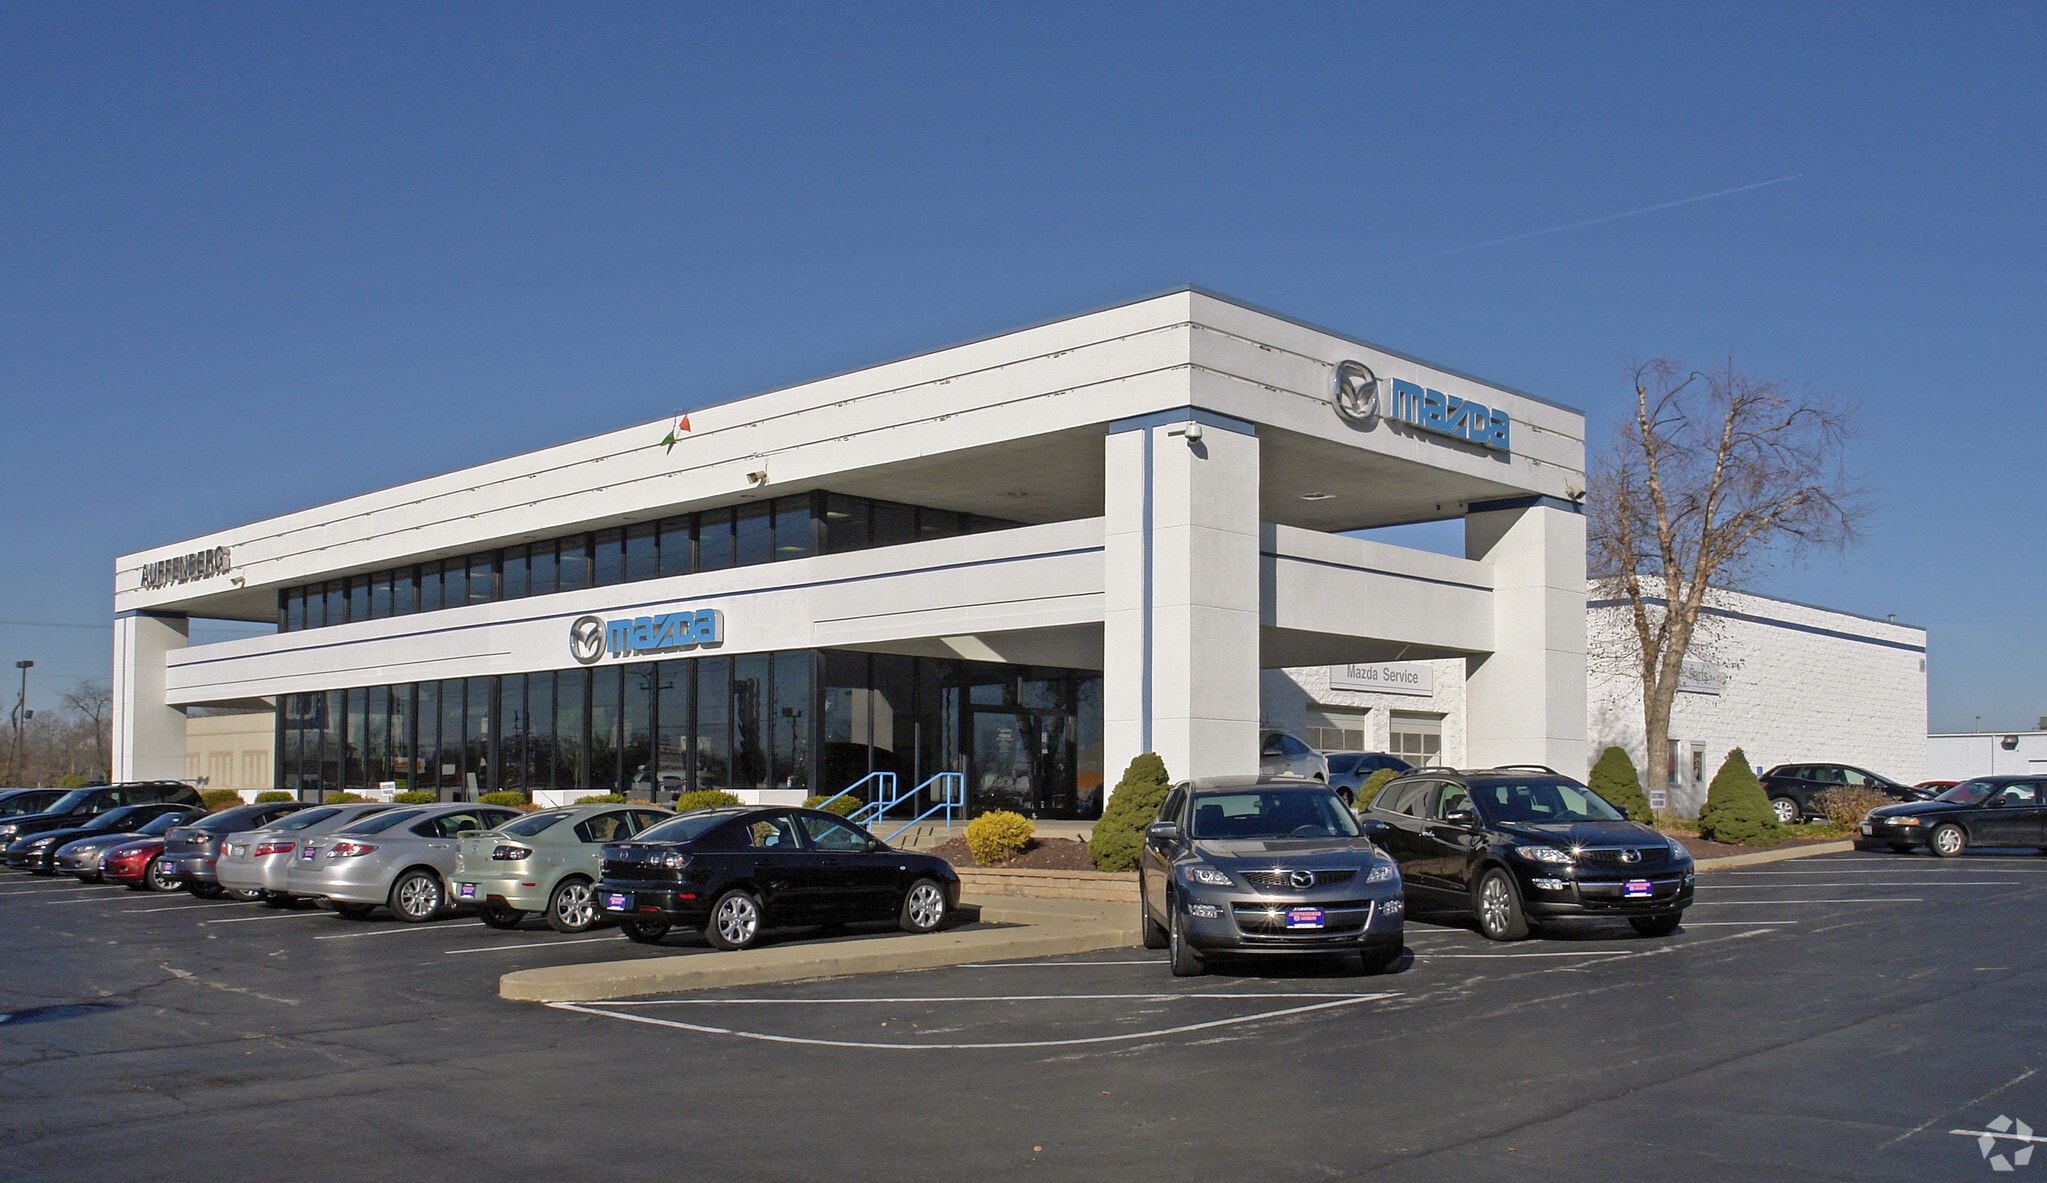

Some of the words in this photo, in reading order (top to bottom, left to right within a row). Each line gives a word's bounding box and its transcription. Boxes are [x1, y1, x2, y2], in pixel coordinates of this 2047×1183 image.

[141, 546, 231, 588] AUFFENBERG
[1347, 664, 1378, 680] Mazda
[1383, 667, 1418, 684] Service
